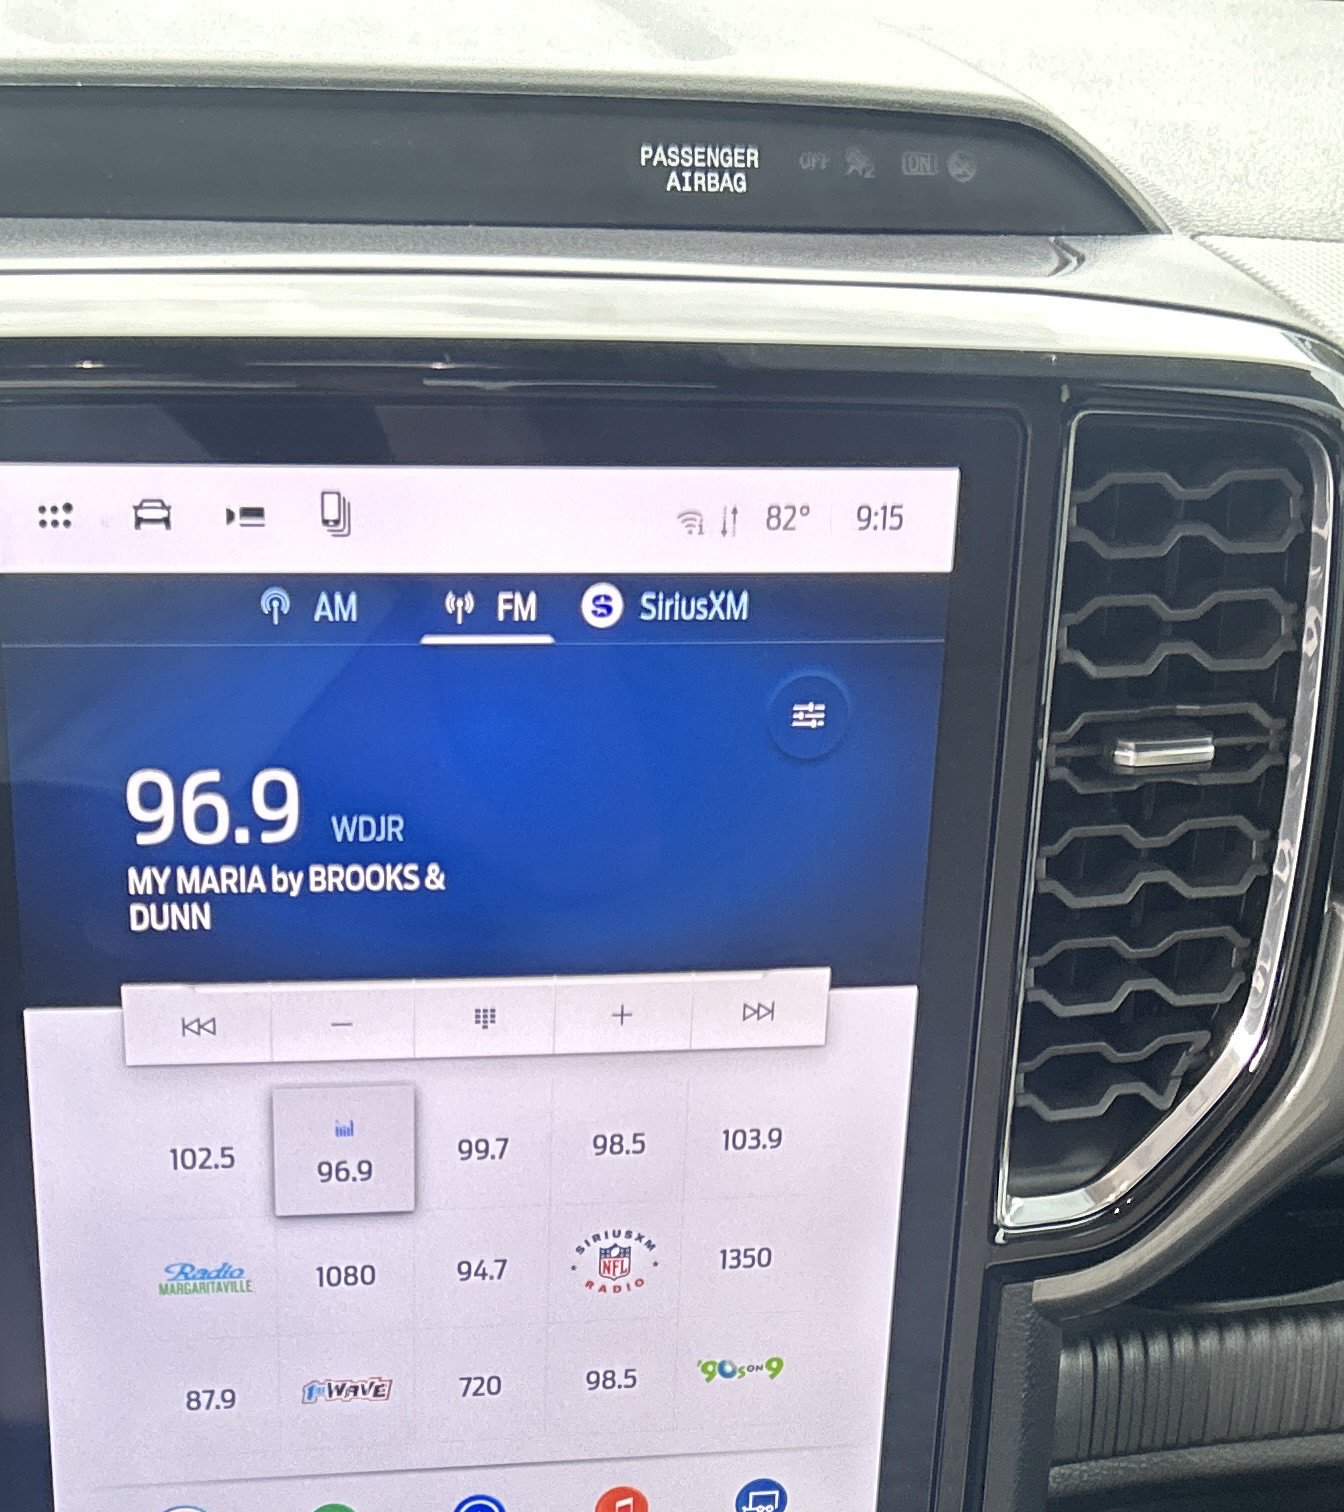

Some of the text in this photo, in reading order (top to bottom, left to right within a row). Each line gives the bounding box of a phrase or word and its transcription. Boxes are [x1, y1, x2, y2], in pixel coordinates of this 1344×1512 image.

[640, 144, 759, 170] PASSENGER
[666, 171, 748, 193] AIRBAG
[856, 504, 905, 531] 9:15
[313, 591, 357, 623] AM
[497, 591, 538, 622] FM
[639, 589, 749, 622] SiriusXM
[126, 768, 406, 846] 96.9 WDJR
[127, 862, 446, 897] MY MARIA by BROOKS &
[129, 902, 212, 932] DUNN
[457, 1136, 510, 1161] 99.7
[592, 1132, 646, 1156] 98.5
[722, 1127, 784, 1152] 103.9
[169, 1146, 236, 1171] 102.5
[316, 1159, 374, 1184] 96.9
[575, 1229, 656, 1256] SIRIUSXM
[457, 1258, 508, 1282] 94.7
[601, 1259, 628, 1277] NFL
[719, 1247, 773, 1270] 1350
[164, 1262, 244, 1281] Radio
[315, 1264, 376, 1288] 1080
[158, 1279, 253, 1296] MARGARITAVILLE
[584, 1278, 645, 1294] RADIO
[459, 1375, 502, 1397] 720
[586, 1369, 638, 1391] 98.5
[185, 1388, 237, 1411] 87.9
